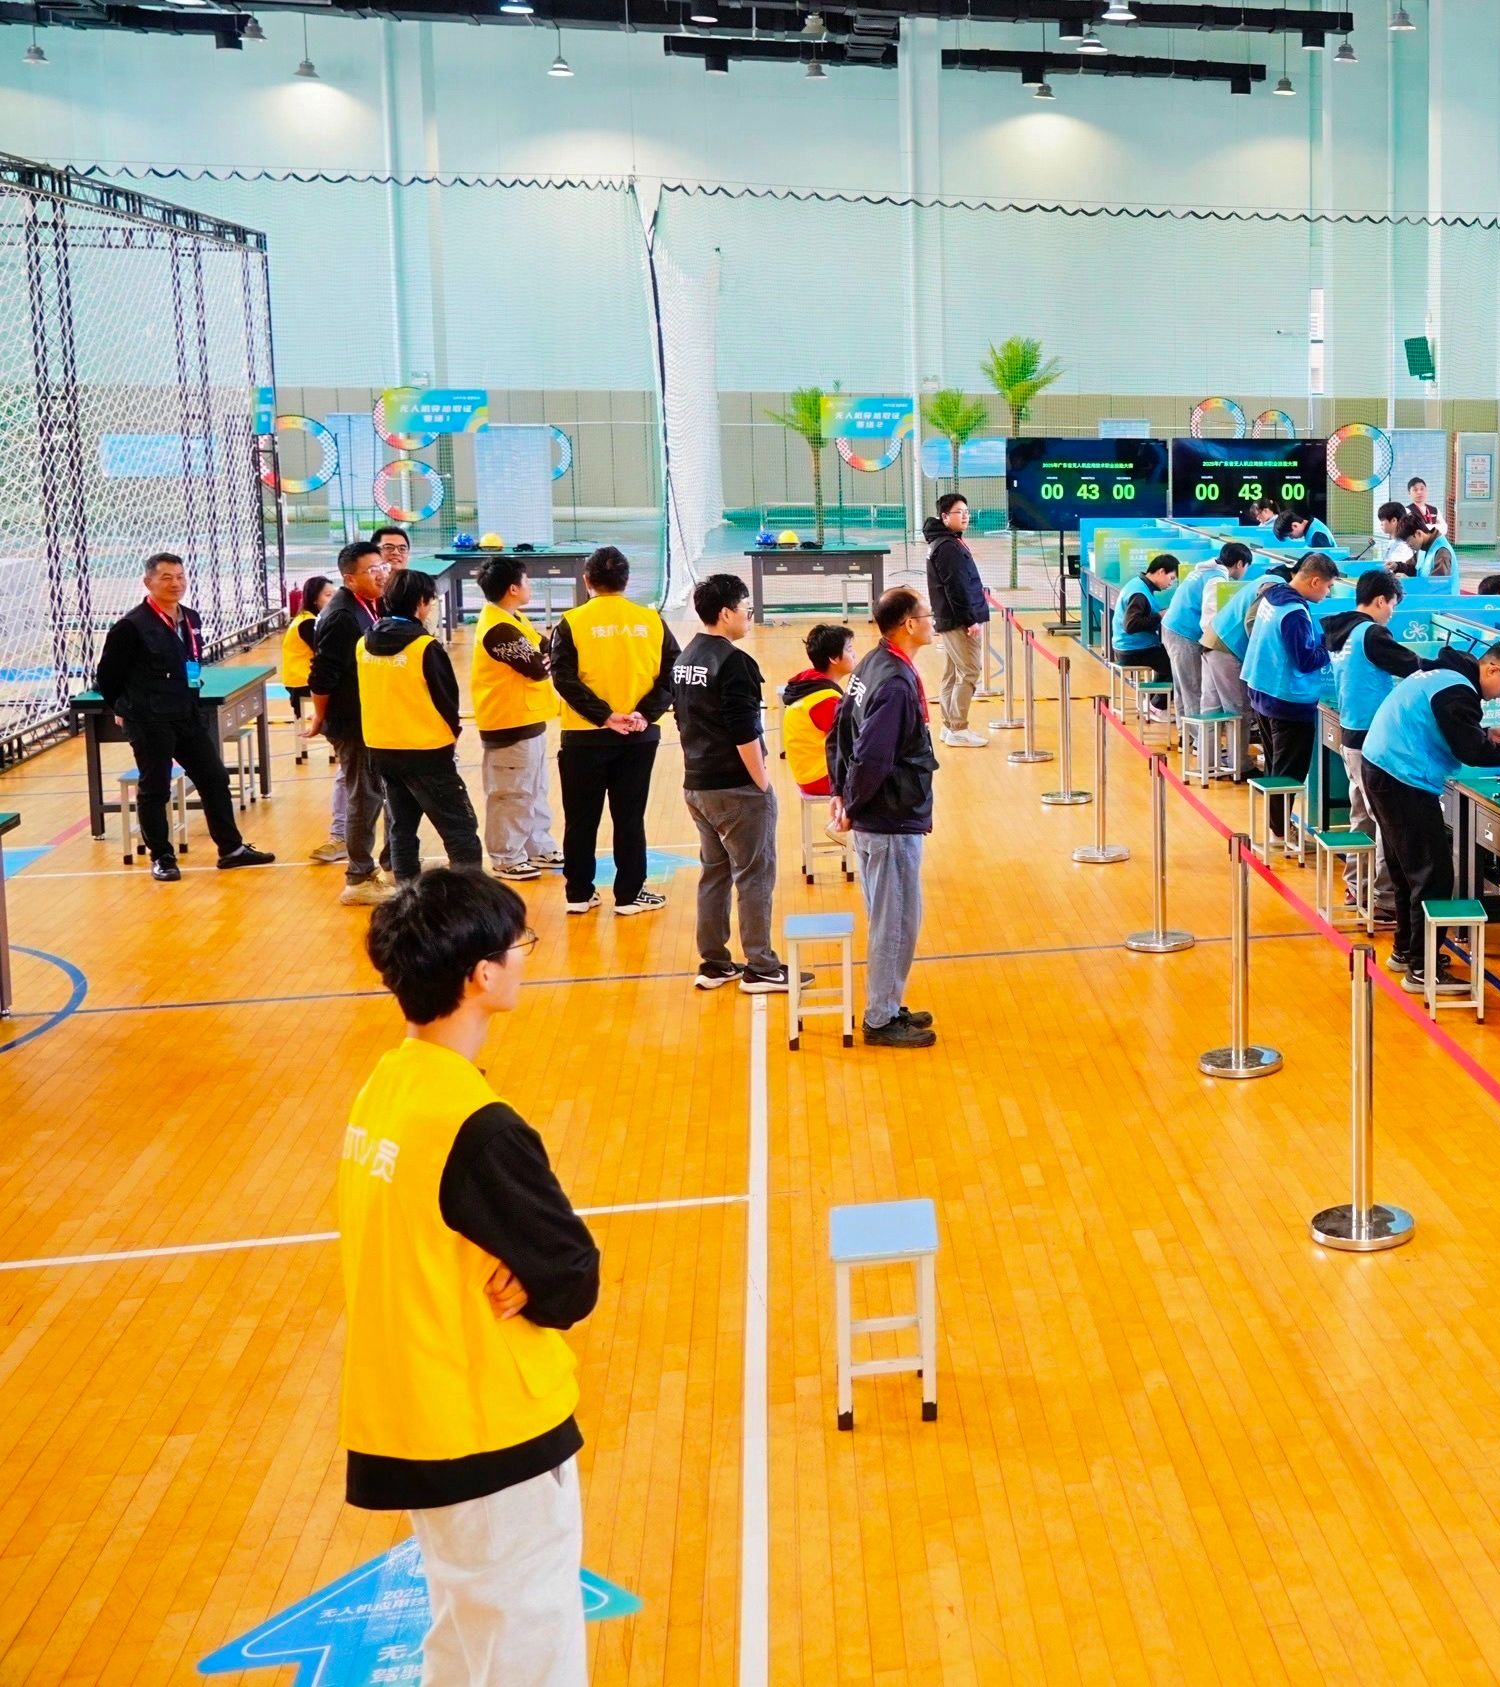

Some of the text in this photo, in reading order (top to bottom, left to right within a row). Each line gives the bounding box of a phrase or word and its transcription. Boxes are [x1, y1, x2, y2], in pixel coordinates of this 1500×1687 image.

[1041, 484, 1135, 499] 00 43 00
[1195, 484, 1305, 500] 00 43 00
[383, 1587, 424, 1601] 2025
